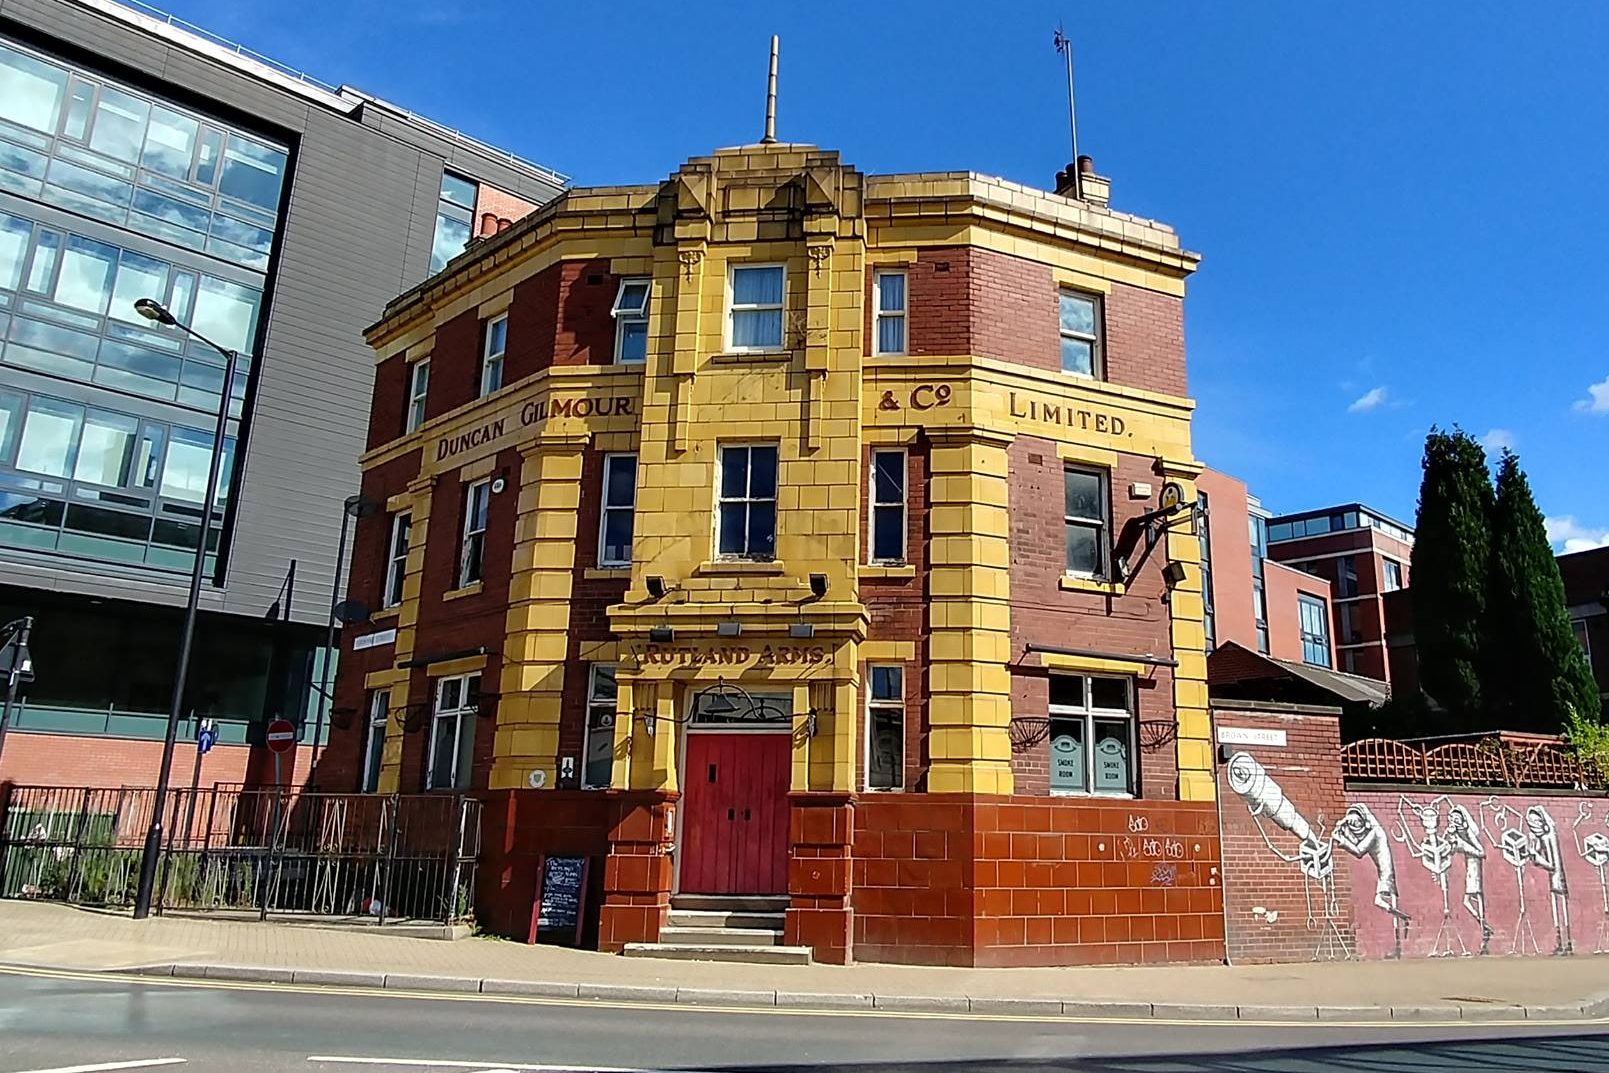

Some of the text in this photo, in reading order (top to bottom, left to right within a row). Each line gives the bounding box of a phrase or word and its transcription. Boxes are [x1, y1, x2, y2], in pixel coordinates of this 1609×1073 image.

[878, 389, 901, 411] &
[437, 396, 632, 462] DUNCAN GILMOUR
[643, 644, 751, 666] RUTLAND
[1057, 759, 1074, 767] SMOKE
[1103, 761, 1119, 769] SMOKE
[1058, 770, 1073, 778] ROOM
